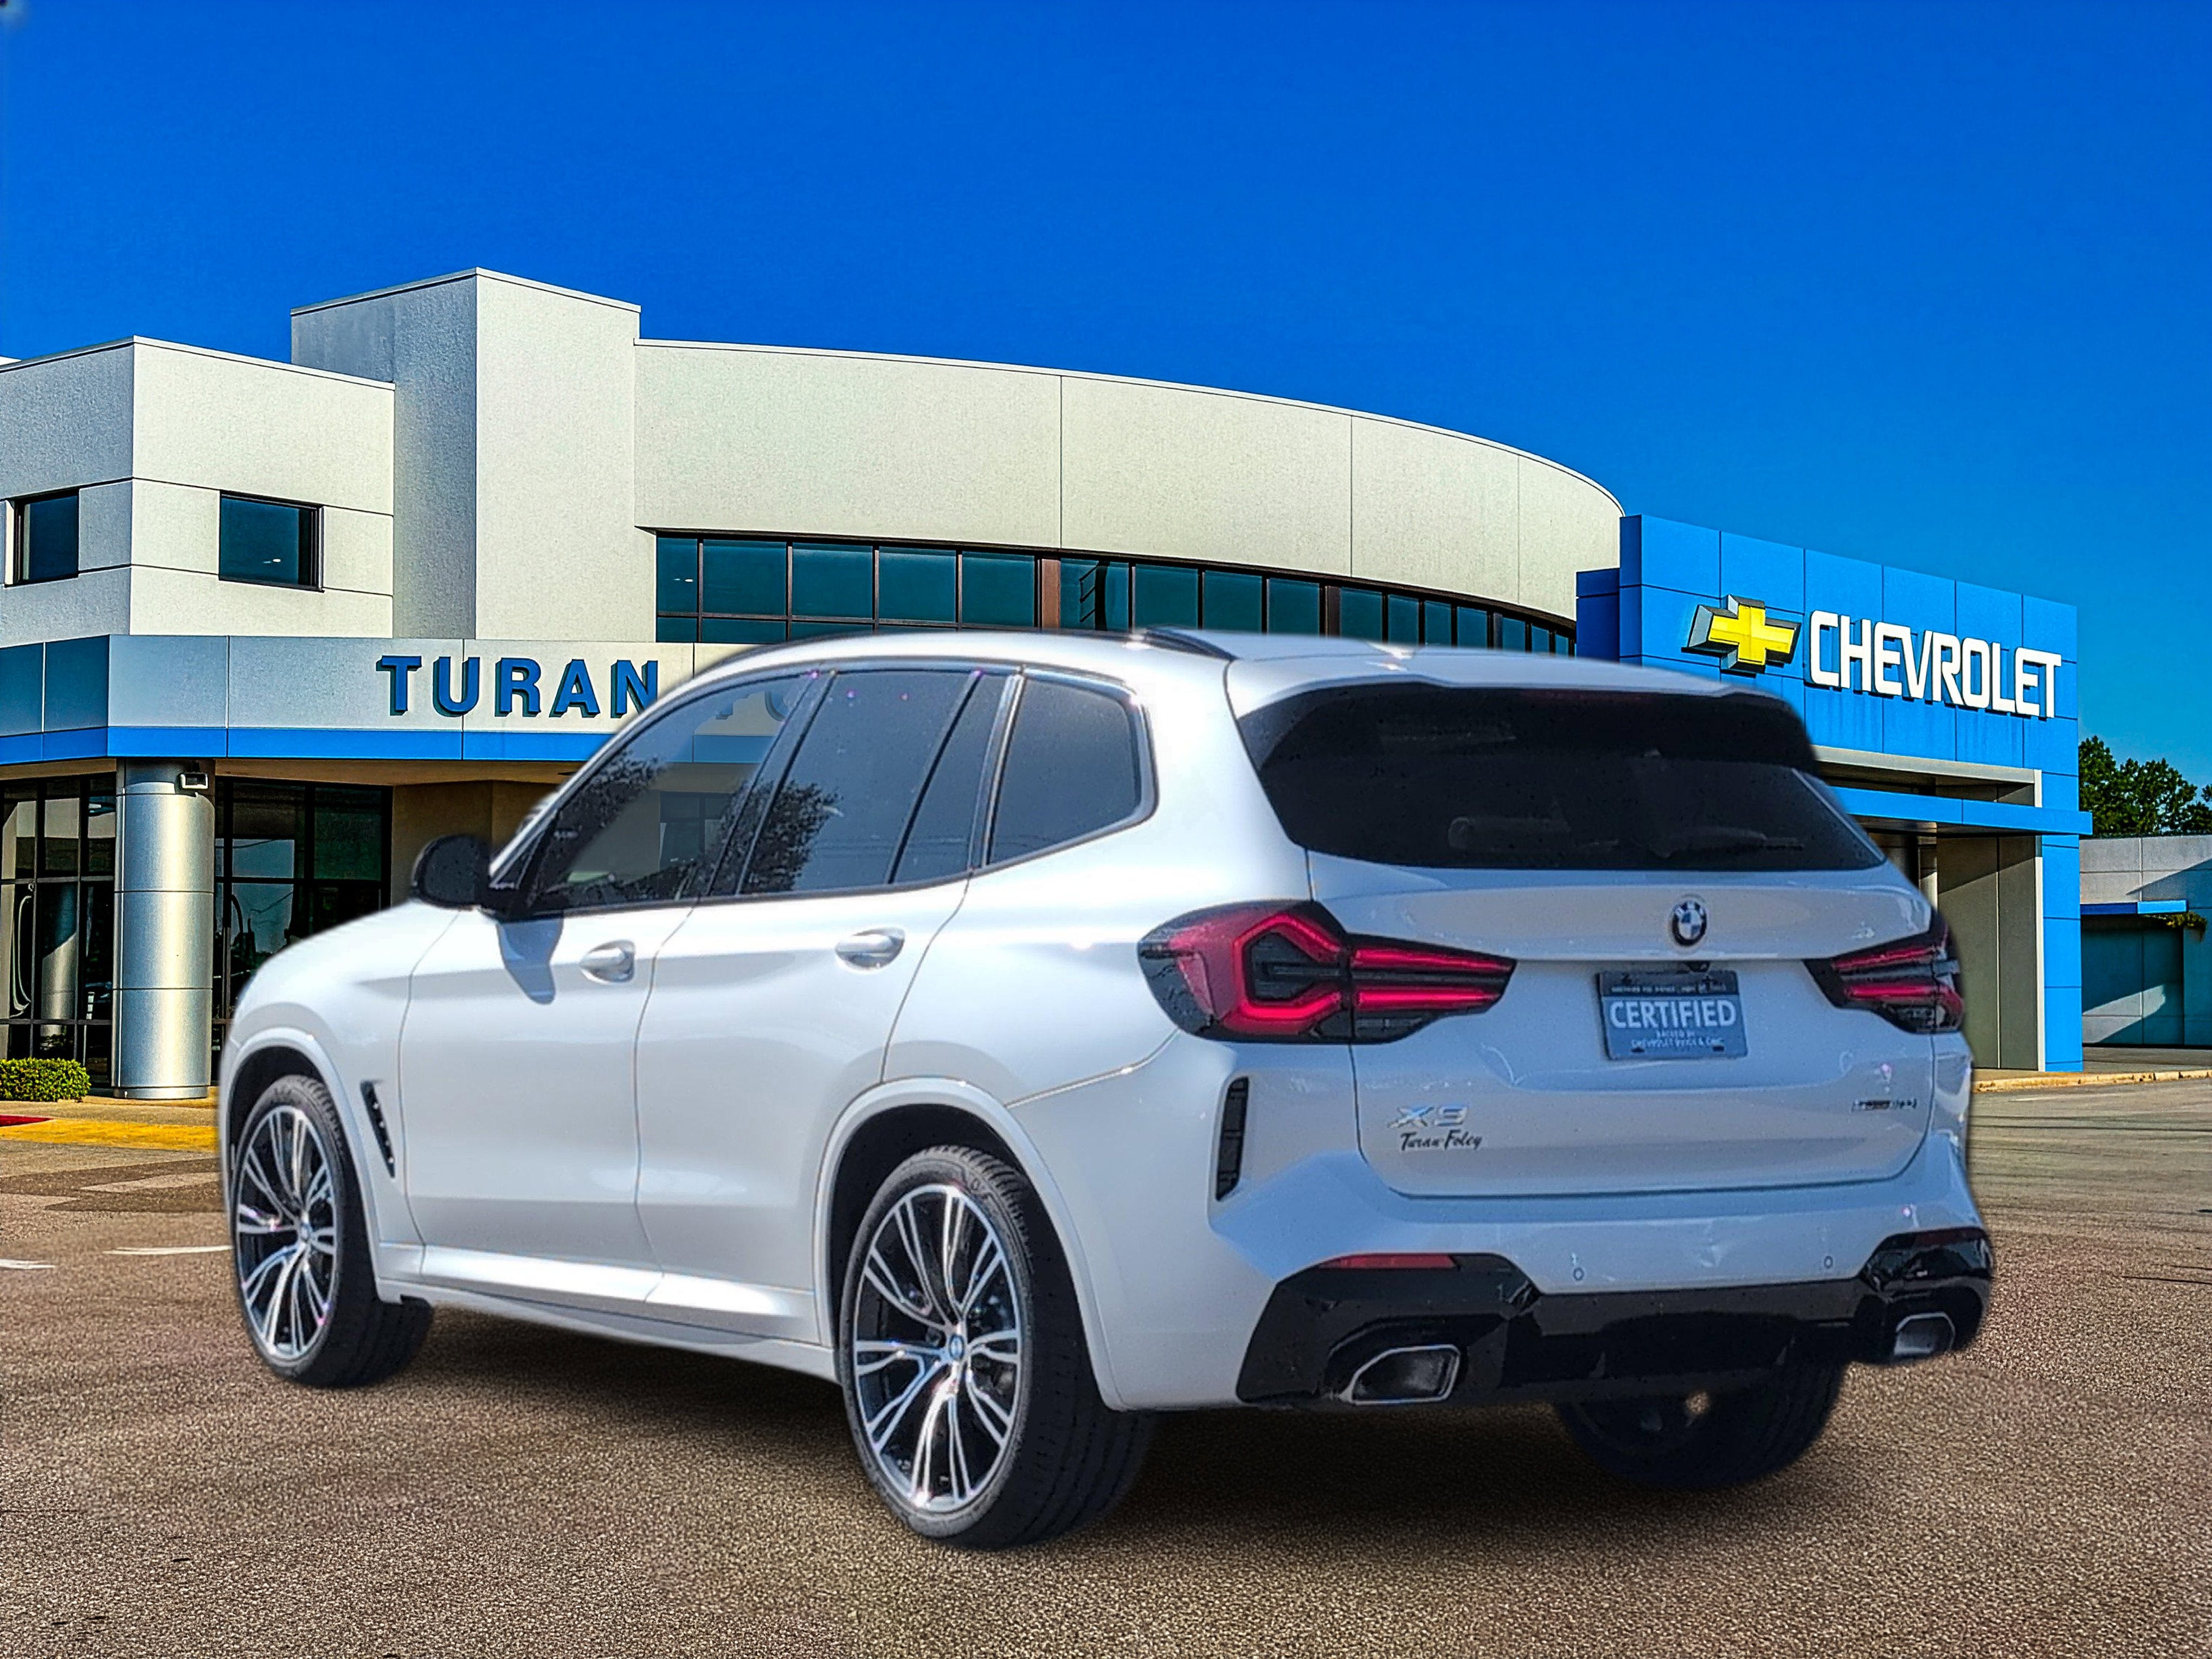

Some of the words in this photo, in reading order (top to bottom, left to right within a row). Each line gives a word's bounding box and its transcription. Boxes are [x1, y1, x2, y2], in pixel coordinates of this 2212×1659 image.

[376, 654, 659, 719] TURAN
[1810, 610, 2062, 718] CHEVROLET
[1609, 999, 1737, 1029] CERTIFIED
